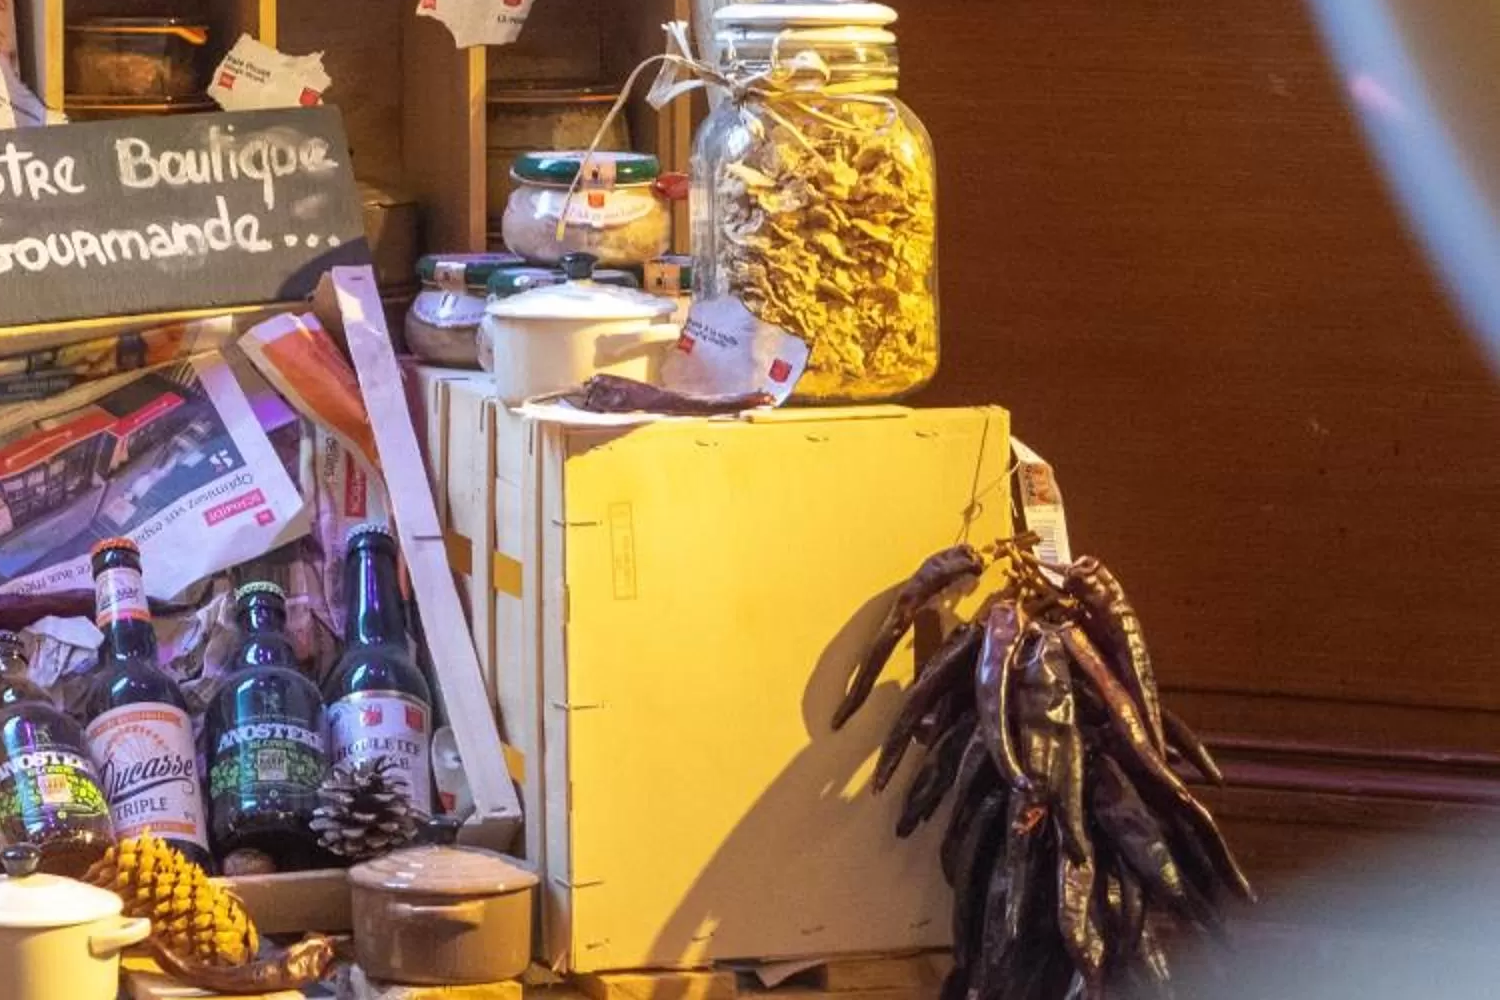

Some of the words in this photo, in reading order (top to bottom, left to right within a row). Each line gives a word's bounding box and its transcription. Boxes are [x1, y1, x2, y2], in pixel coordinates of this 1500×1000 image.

[114, 124, 339, 211] Boutique
[100, 752, 195, 802] Ducasse
[115, 796, 169, 821] TRIPLE
